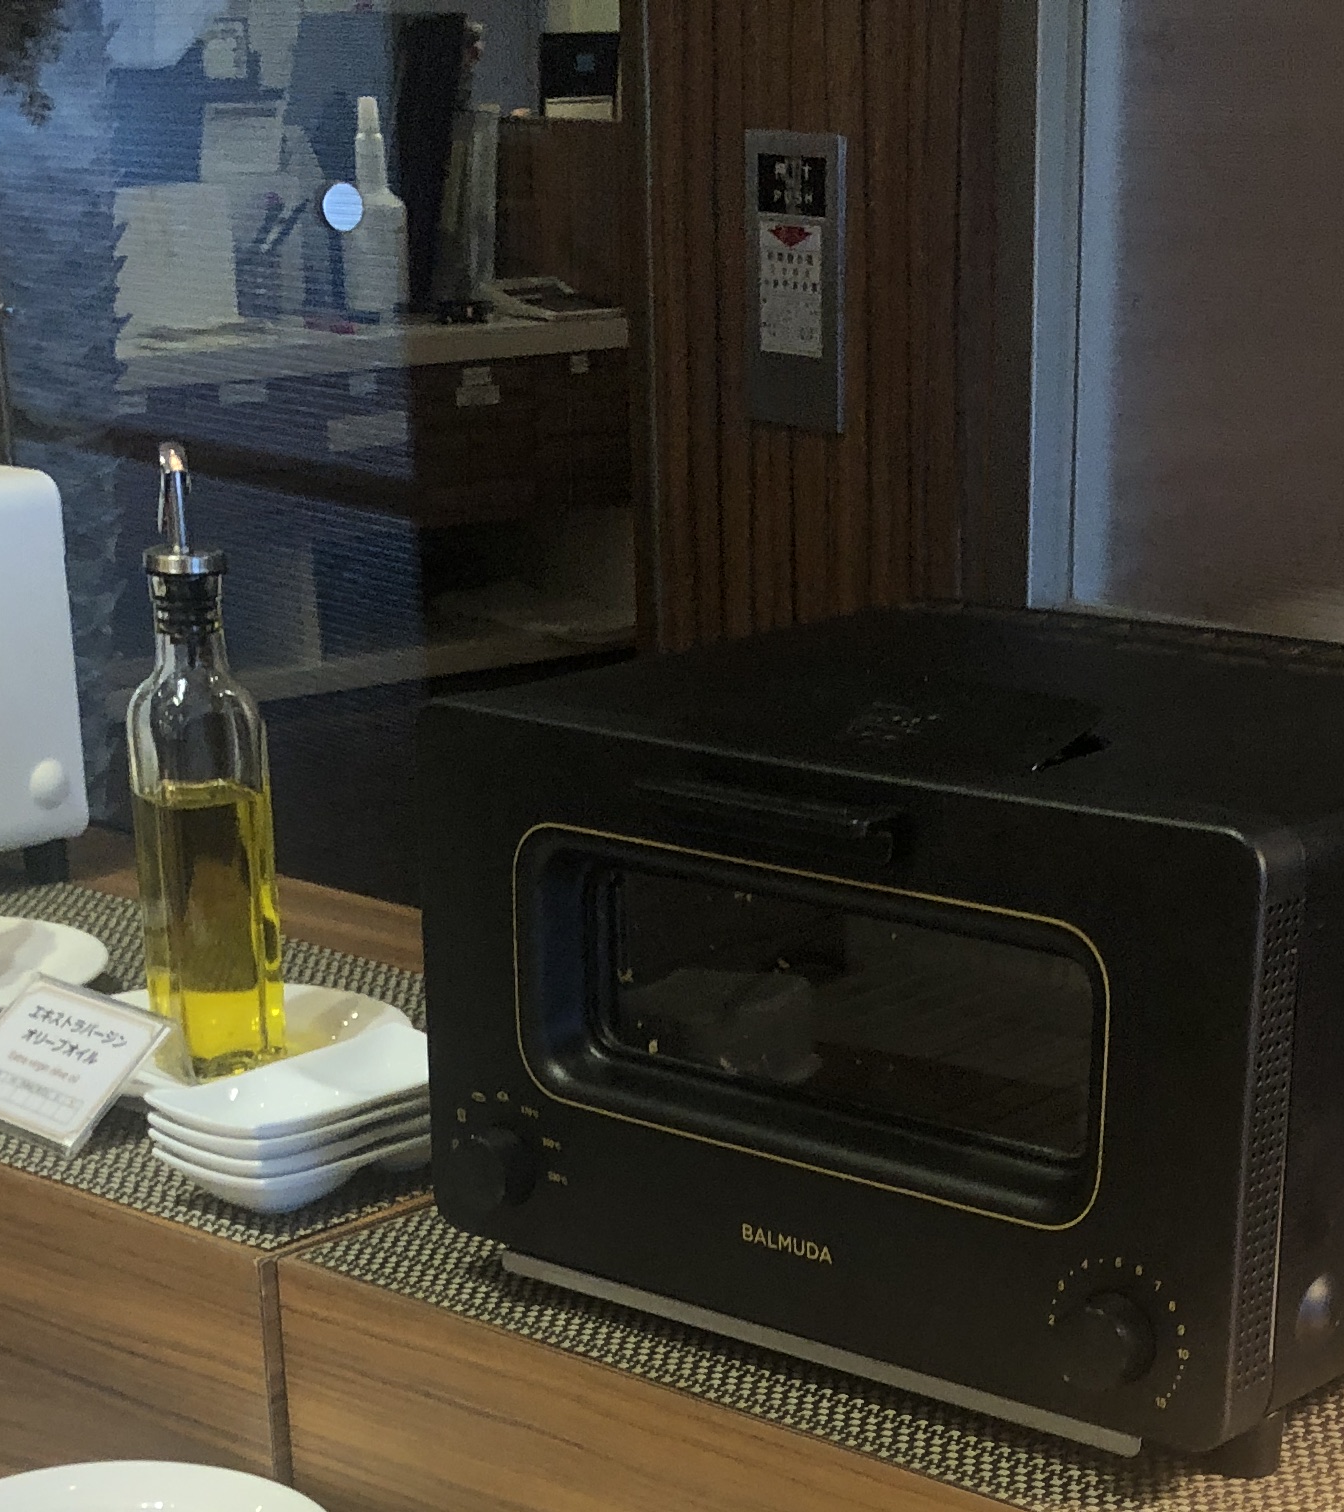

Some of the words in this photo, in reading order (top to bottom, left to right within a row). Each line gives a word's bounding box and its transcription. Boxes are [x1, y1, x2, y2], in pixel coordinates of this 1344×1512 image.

[28, 1005, 128, 1049] エキストラバージン
[20, 1028, 99, 1065] オリーブオイル
[742, 1223, 833, 1265] BALMUDA
[1154, 1280, 1163, 1292] 7
[1048, 1314, 1056, 1327] 2
[1177, 1348, 1190, 1361] 10
